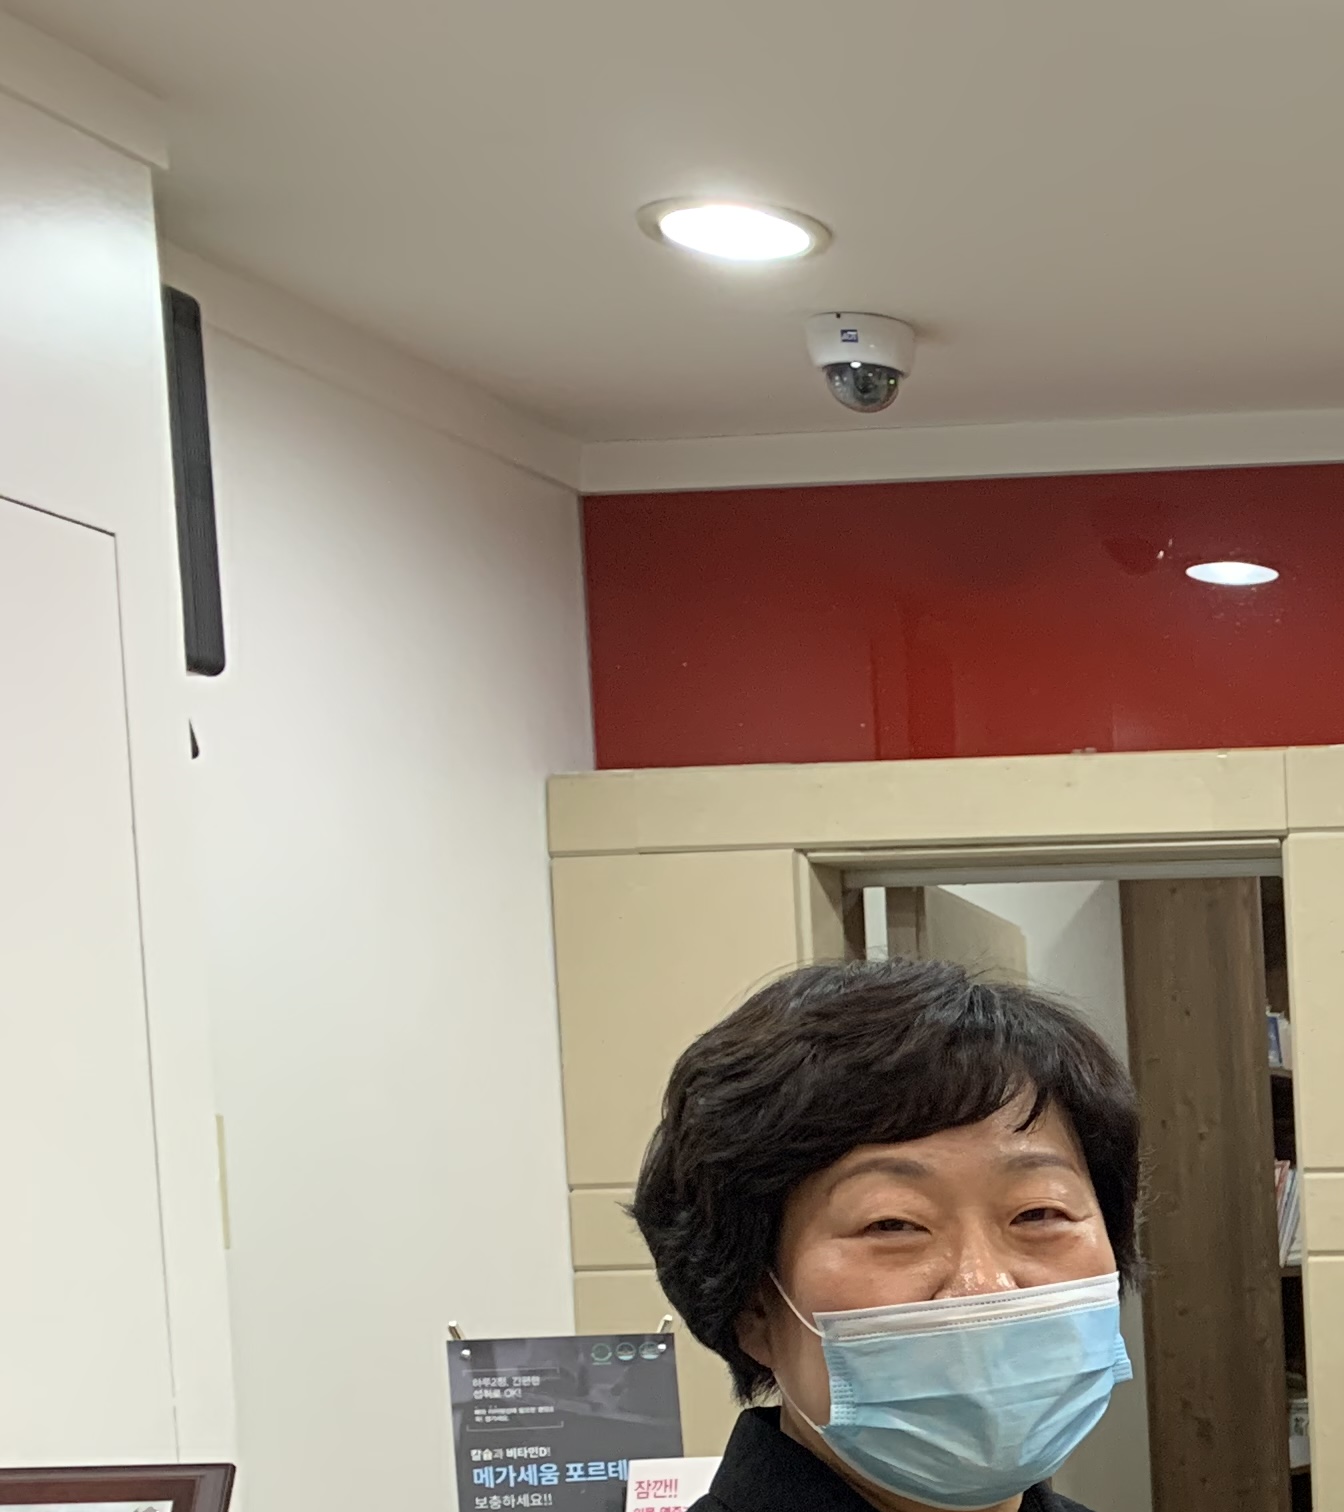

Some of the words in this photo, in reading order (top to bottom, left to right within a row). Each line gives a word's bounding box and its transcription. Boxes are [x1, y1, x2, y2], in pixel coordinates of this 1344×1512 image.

[472, 1462, 560, 1489] 메가세움
[565, 1459, 628, 1483] 포르테
[634, 1479, 678, 1499] 잠깐!!
[474, 1493, 553, 1510] 보충하세요!!
